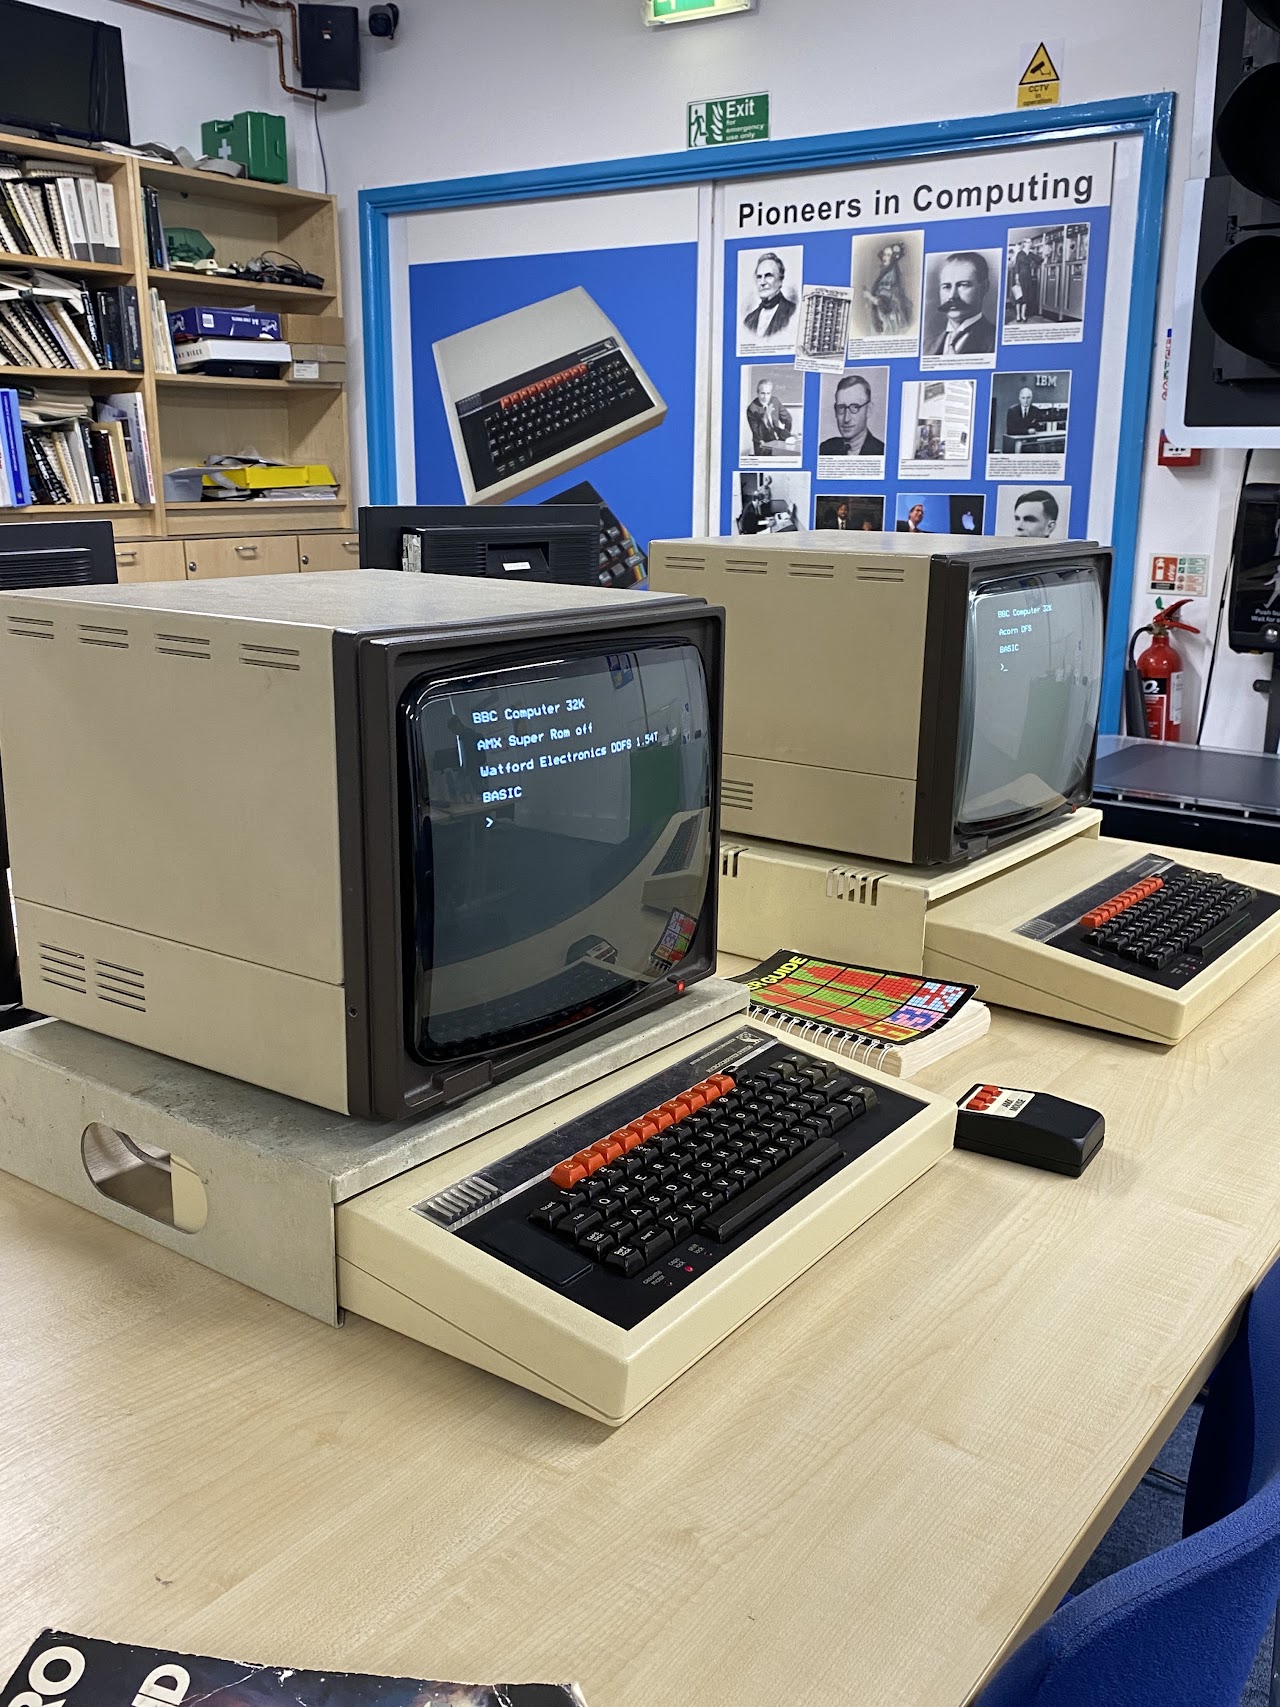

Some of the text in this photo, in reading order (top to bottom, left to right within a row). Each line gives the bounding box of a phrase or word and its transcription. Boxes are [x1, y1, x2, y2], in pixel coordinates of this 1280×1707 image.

[1029, 84, 1050, 92] CCTV
[726, 98, 755, 118] Exit
[726, 124, 765, 133] emergency
[740, 132, 756, 140] only
[739, 172, 1094, 228] Pioneers in Computing
[1036, 375, 1057, 386] IBM
[998, 610, 1010, 618] BBC
[1012, 606, 1041, 617] Computer
[999, 628, 1018, 636] Acorn
[1000, 644, 1020, 654] BASIC
[472, 698, 586, 724] BBC Computer 32K
[476, 722, 593, 752] AMX Super Rom off
[480, 758, 534, 778] Watford
[539, 744, 607, 768] Electronics
[610, 738, 632, 754] DDFS
[482, 785, 522, 803] BASIC
[485, 817, 494, 828] >
[760, 956, 808, 984] GUIDE
[615, 1185, 629, 1193] W
